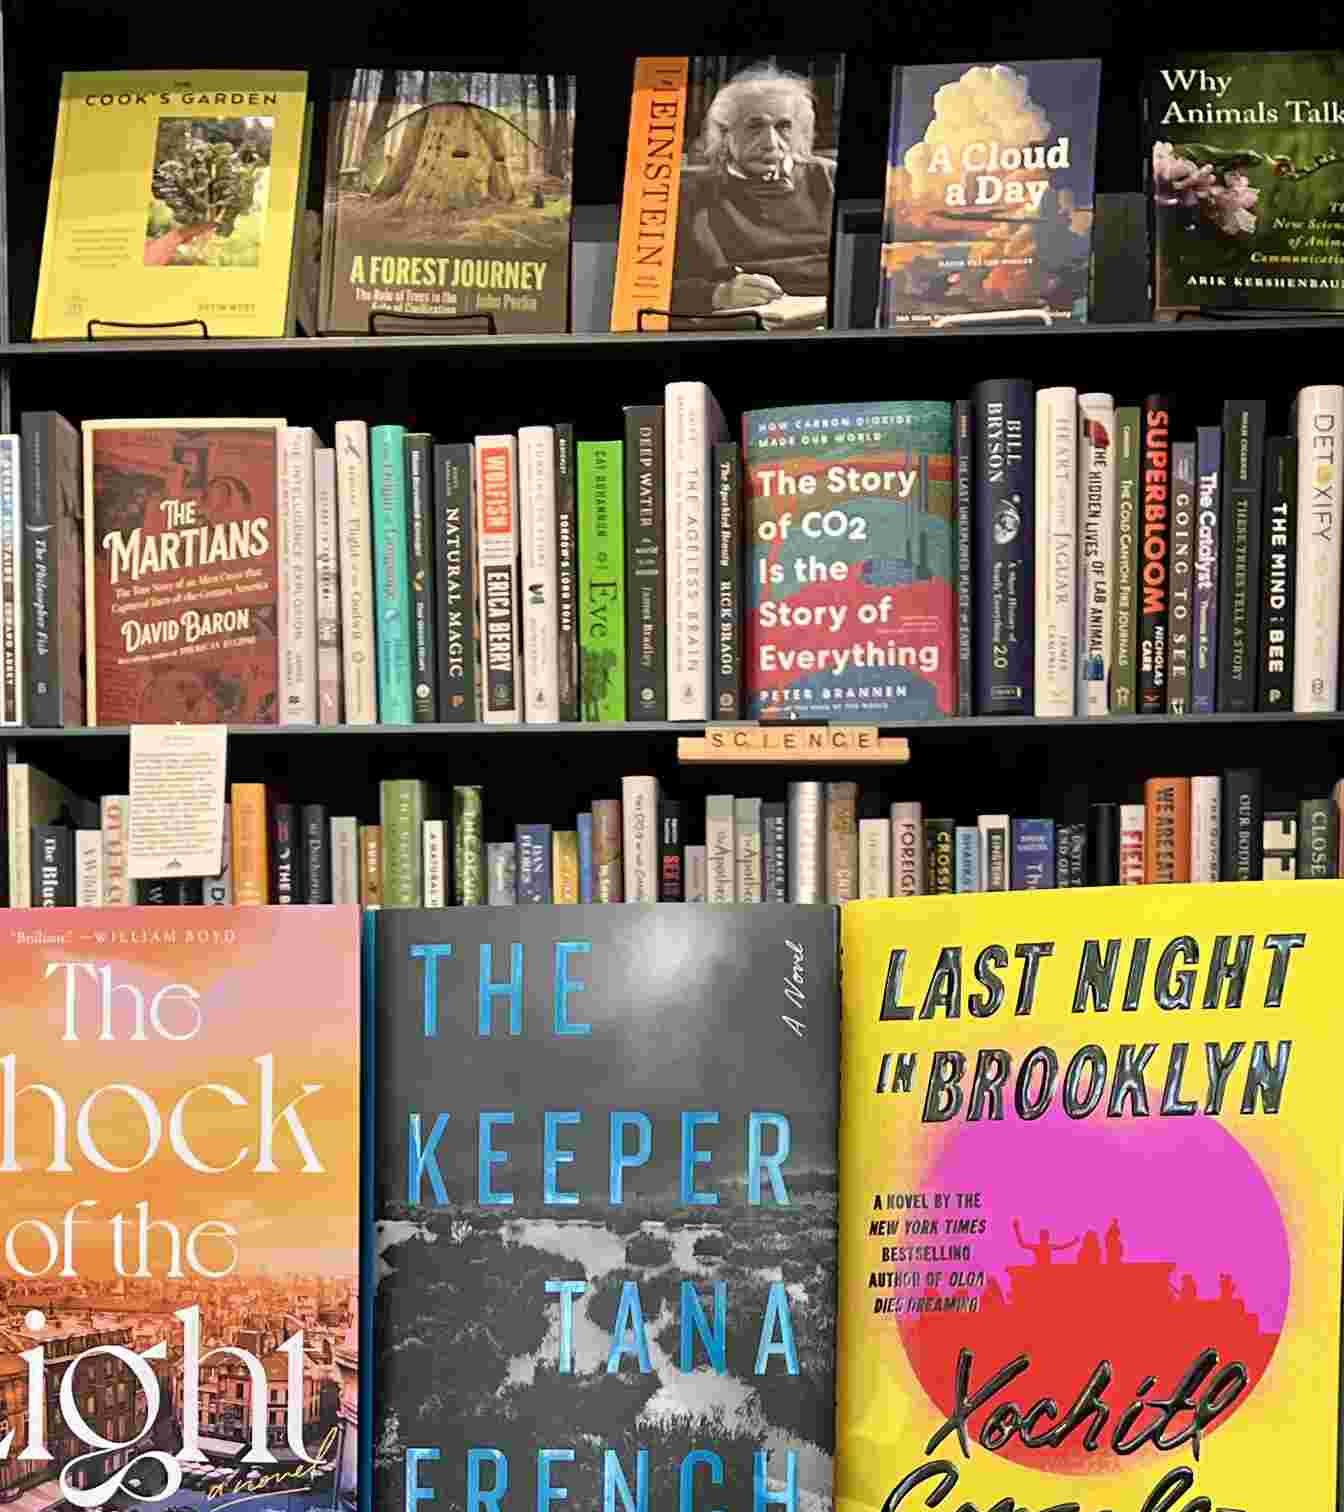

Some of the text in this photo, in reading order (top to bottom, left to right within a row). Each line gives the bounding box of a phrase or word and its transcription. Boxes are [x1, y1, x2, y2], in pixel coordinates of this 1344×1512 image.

[181, 90, 278, 105] GARDEN
[1161, 70, 1231, 96] Why
[1161, 100, 1278, 124] Animals
[641, 100, 680, 266] EINSTEIN
[928, 137, 1070, 174] A Cloud
[945, 177, 1049, 210] a Day
[350, 255, 546, 290] A FOREST JOURNEY
[1188, 274, 1228, 287] ARIK
[987, 402, 1003, 484] BRYSON
[1007, 420, 1023, 465] BILL
[161, 499, 198, 530] THE
[483, 453, 511, 529] WOLFISH
[757, 466, 918, 505] The Story
[1143, 408, 1169, 615] SUPERBLOOM
[103, 517, 269, 585] MARTIANS
[758, 512, 792, 540] of
[1174, 493, 1190, 575] GOING
[1195, 472, 1218, 591] The Catalyst
[446, 508, 464, 679] NATURAL MAGIC
[760, 556, 849, 583] Is the
[1269, 504, 1288, 673] THE MIND BEE
[121, 608, 250, 654] DAVID BARON
[487, 572, 513, 673] ERICA BERRY
[590, 580, 617, 642] Eve
[759, 595, 893, 632] Story of
[759, 639, 940, 675] Everything
[759, 686, 908, 702] PETER BRANNEN
[711, 730, 870, 751] SCIENCE
[1310, 811, 1327, 877] CLOSE
[45, 961, 201, 1043] The
[410, 940, 593, 1038] THE
[878, 932, 1308, 1023] LAST NIGHT
[921, 1041, 1293, 1123] BROOKLYN
[406, 1110, 793, 1206] KEEPER
[545, 1278, 801, 1377] TANA
